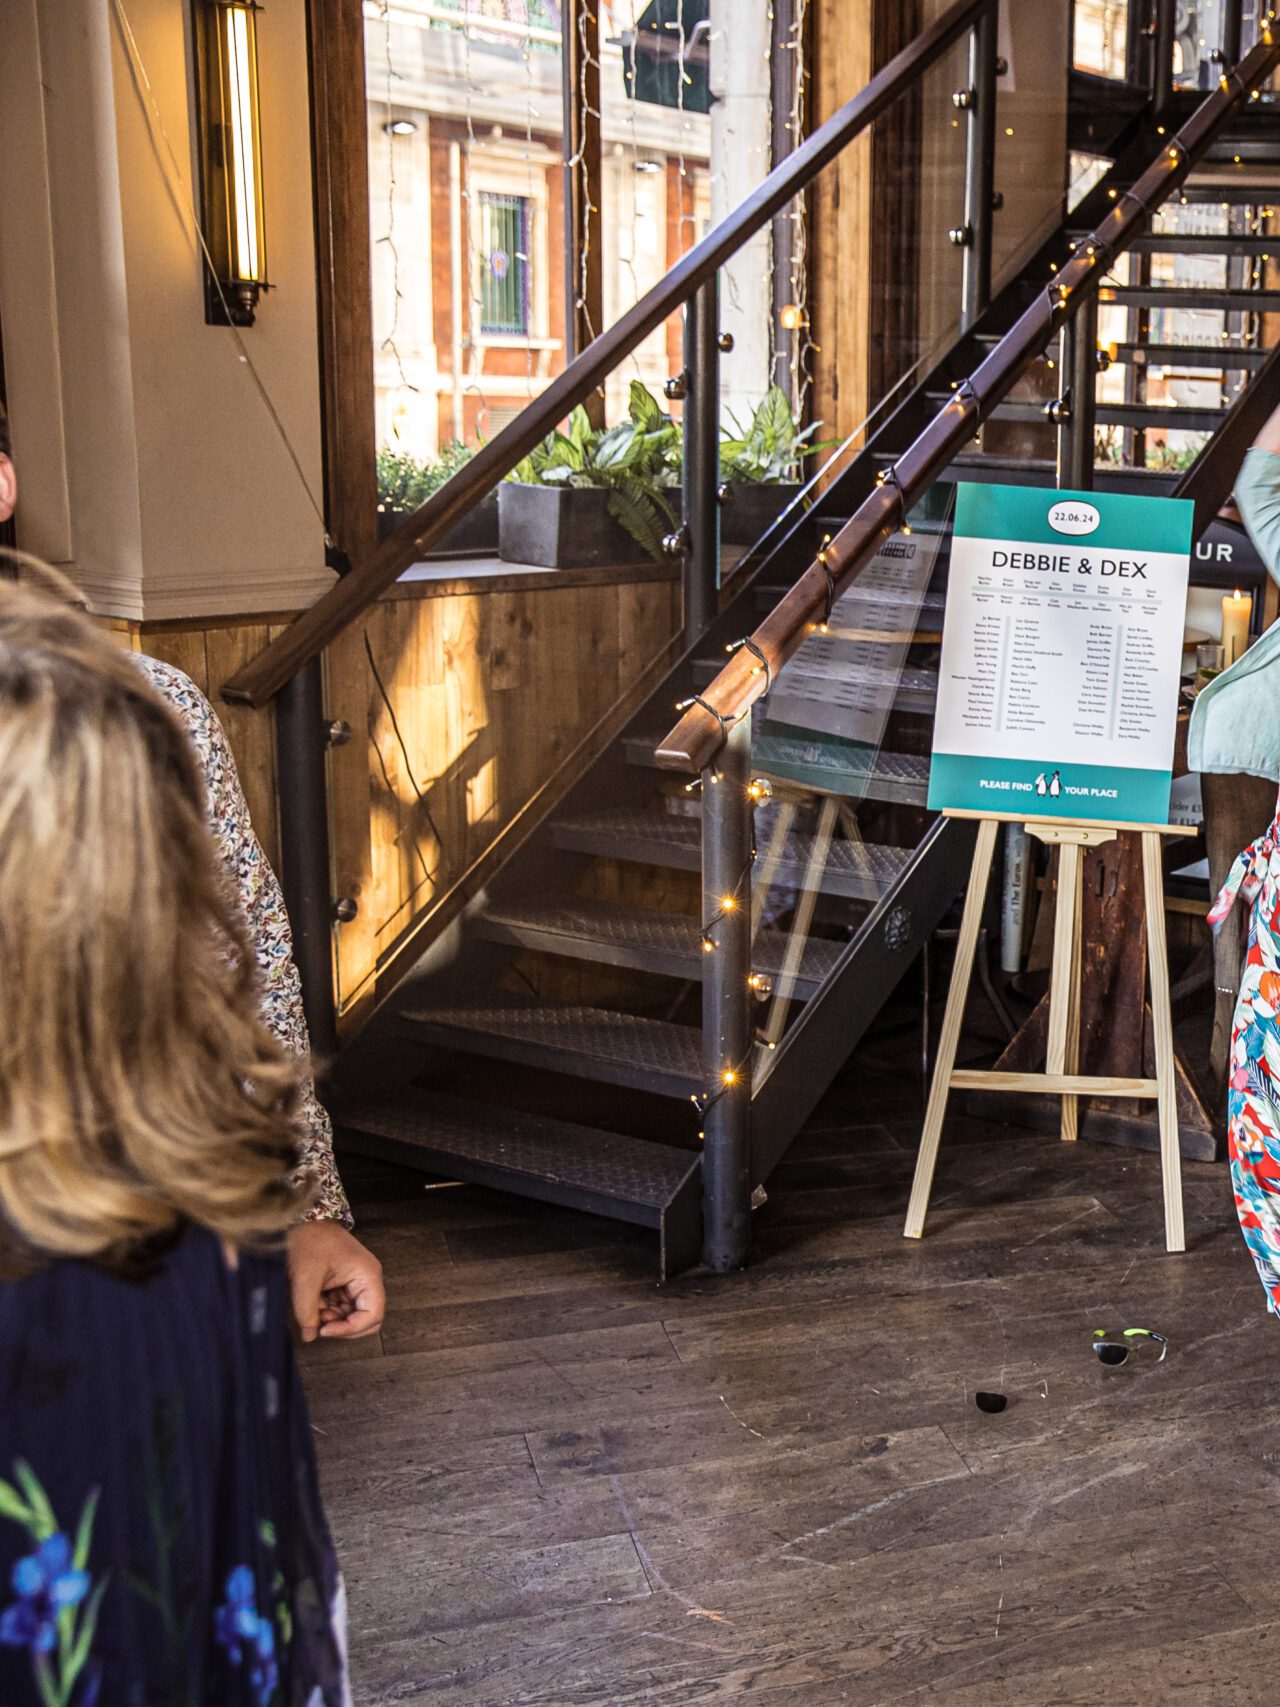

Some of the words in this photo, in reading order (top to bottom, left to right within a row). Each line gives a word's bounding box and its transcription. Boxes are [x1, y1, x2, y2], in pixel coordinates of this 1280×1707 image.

[1054, 512, 1094, 523] 22.06.24
[992, 551, 1071, 573] DEBBIE
[1077, 558, 1093, 575] &
[1100, 560, 1148, 579] DEX
[979, 779, 1011, 790] PLEASE
[1012, 780, 1033, 791] FIND
[1065, 786, 1089, 796] YOUR
[1090, 788, 1118, 798] PLACE
[1011, 889, 1020, 906] The
